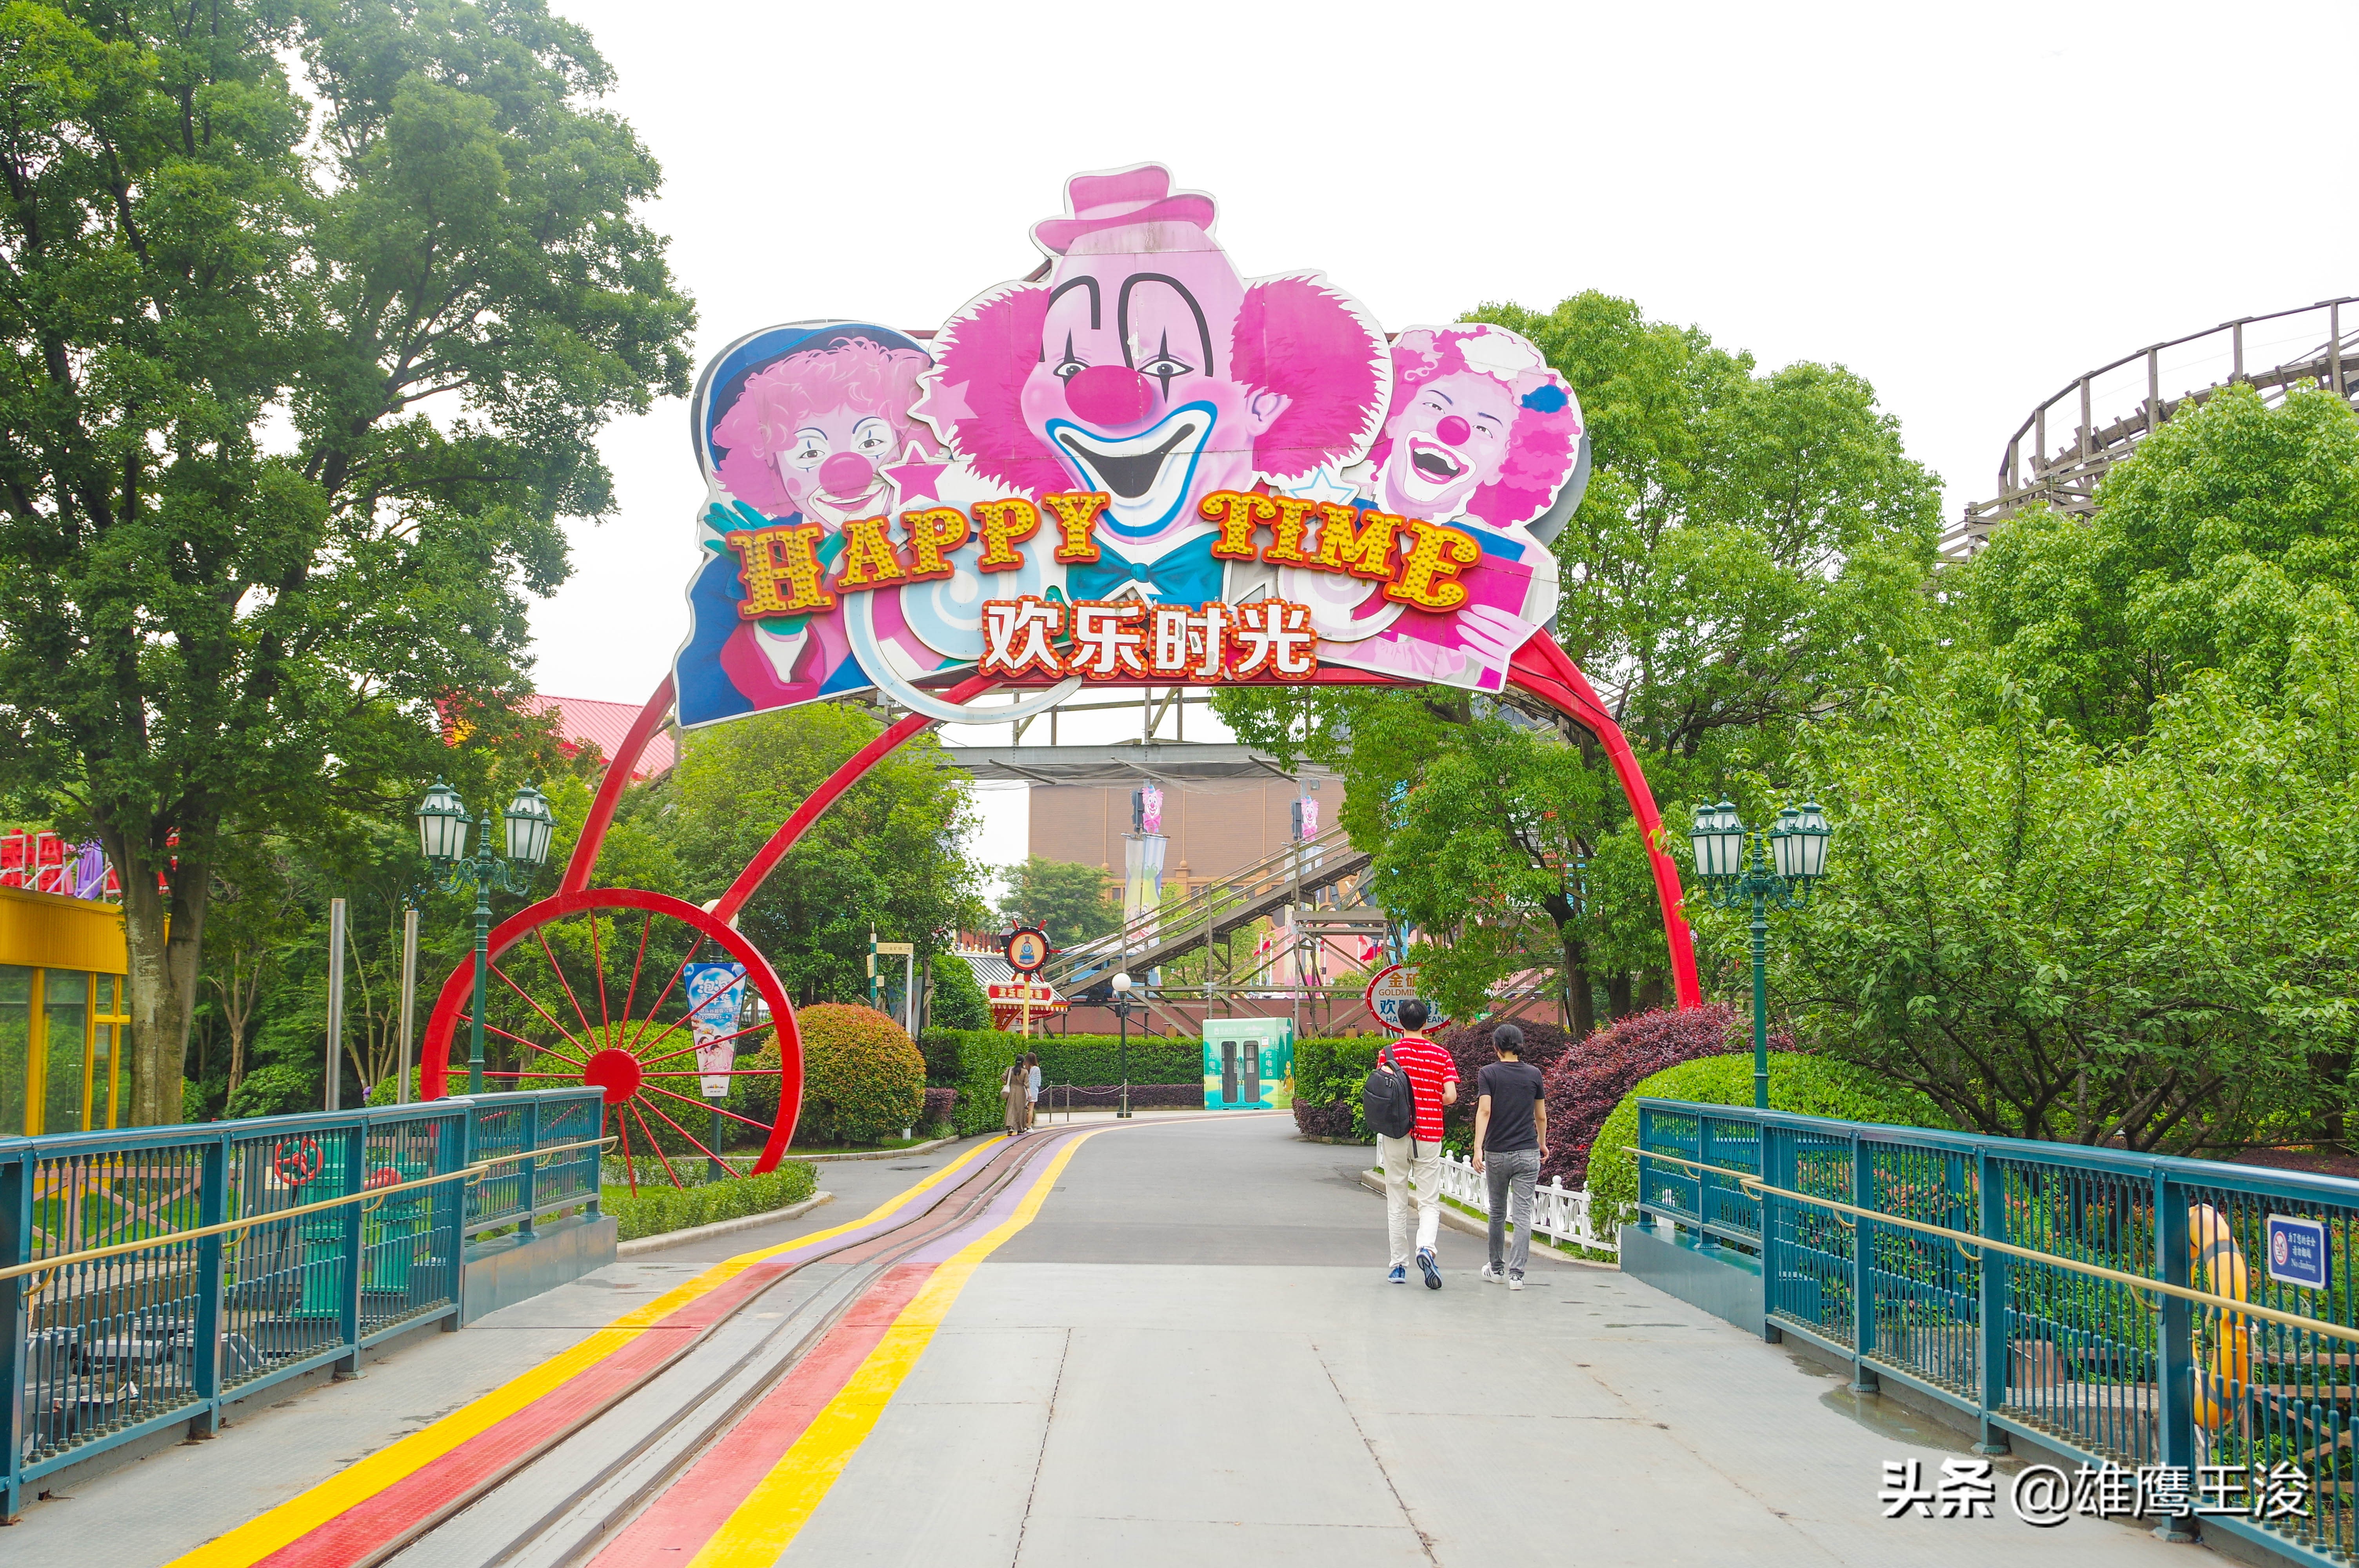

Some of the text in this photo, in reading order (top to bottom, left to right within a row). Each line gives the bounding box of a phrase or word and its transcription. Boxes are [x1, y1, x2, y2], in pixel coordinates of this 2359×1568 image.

[726, 490, 1481, 619] HAPPY TIME
[980, 596, 1315, 681] 欢乐时光
[1265, 1051, 1273, 1076] 充电站
[2288, 1232, 2316, 1247] 为了您的安全
